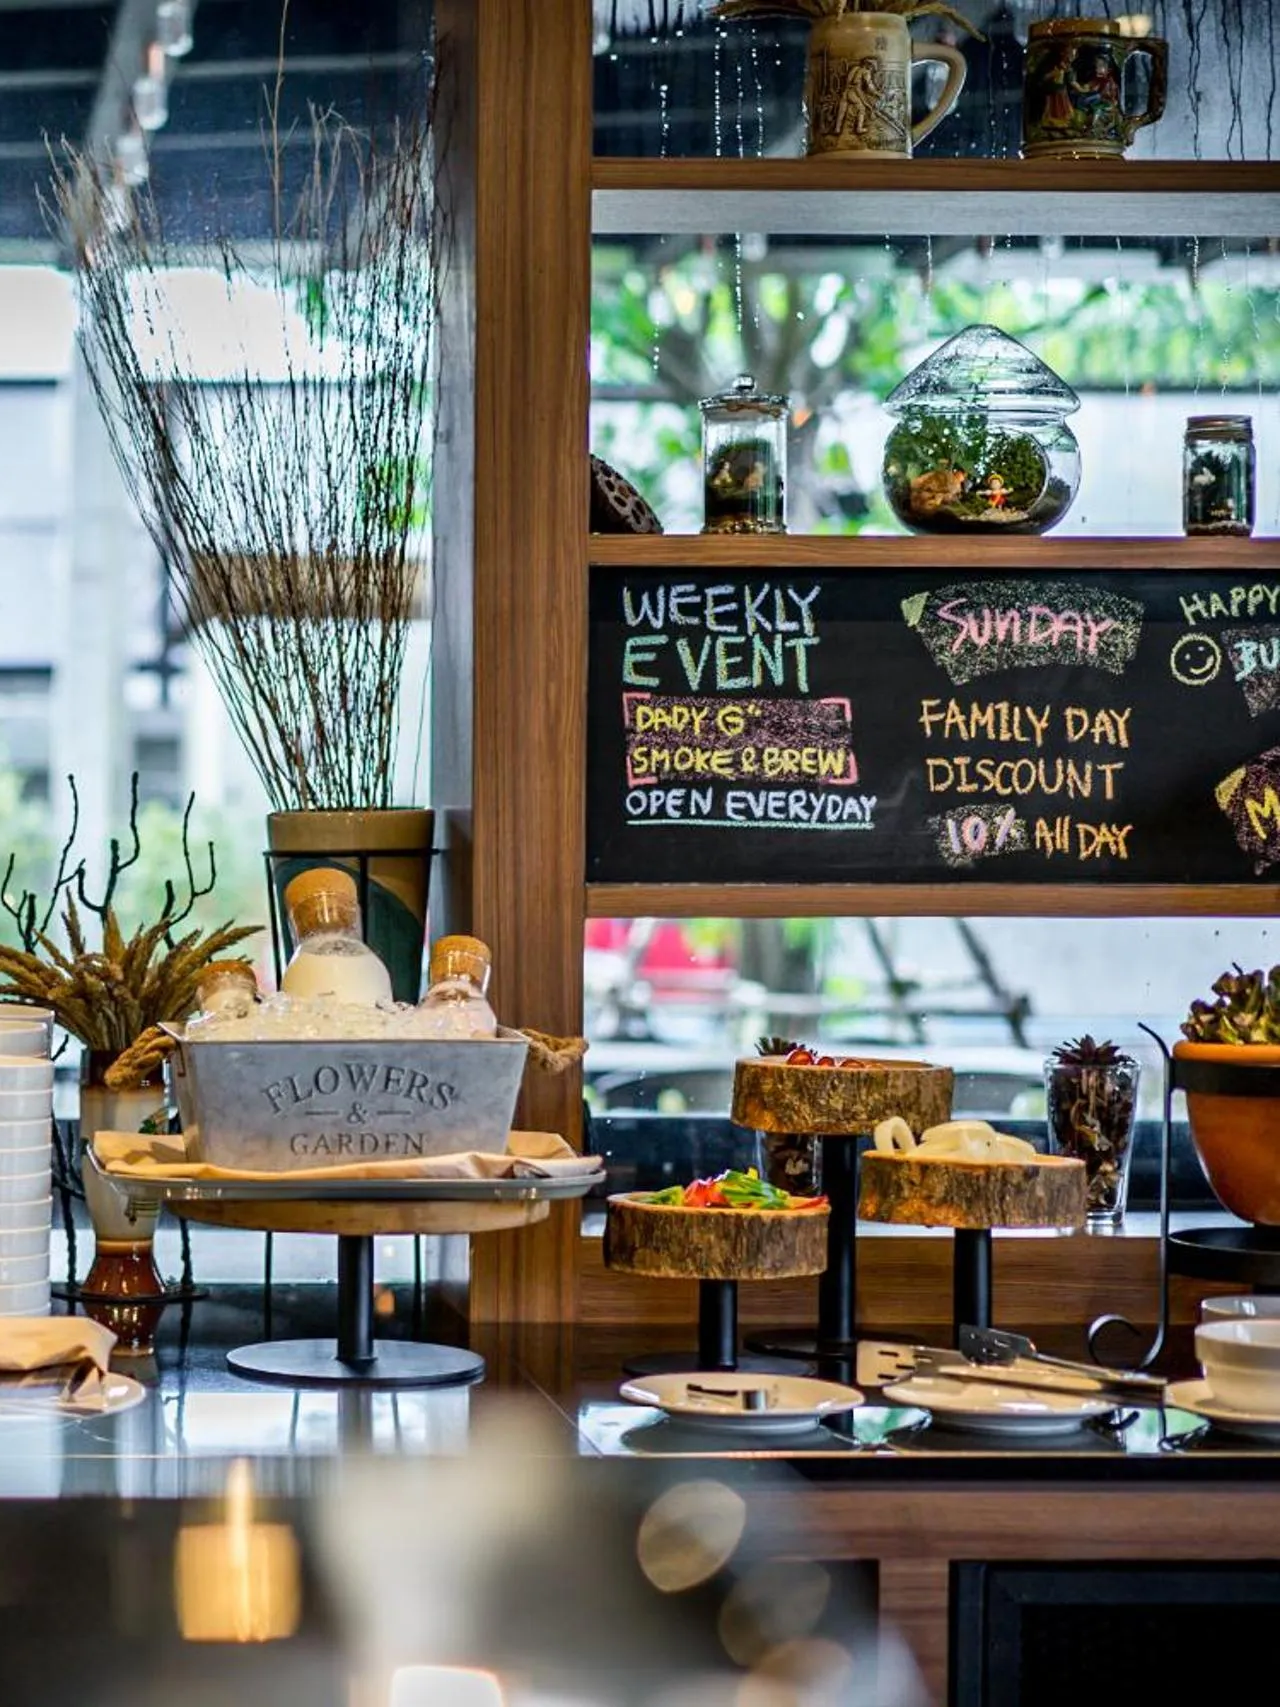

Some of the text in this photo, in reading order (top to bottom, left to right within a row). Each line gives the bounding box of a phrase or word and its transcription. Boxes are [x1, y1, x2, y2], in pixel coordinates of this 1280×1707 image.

[623, 583, 821, 636] WEEKLY
[1178, 583, 1280, 626] HAPPY
[622, 634, 820, 693] EVENT
[635, 705, 708, 735] DADY
[919, 698, 1132, 748] FAMILY DAY
[632, 746, 736, 781] SMOKE
[763, 747, 846, 777] BREW
[926, 756, 1124, 800] DISCOUNT
[626, 787, 878, 823] OPEN EVERYDAY
[1076, 822, 1134, 861] DAY
[261, 1062, 458, 1116] FLOWERS
[346, 1101, 368, 1125] &
[290, 1132, 427, 1156] GARDEN
